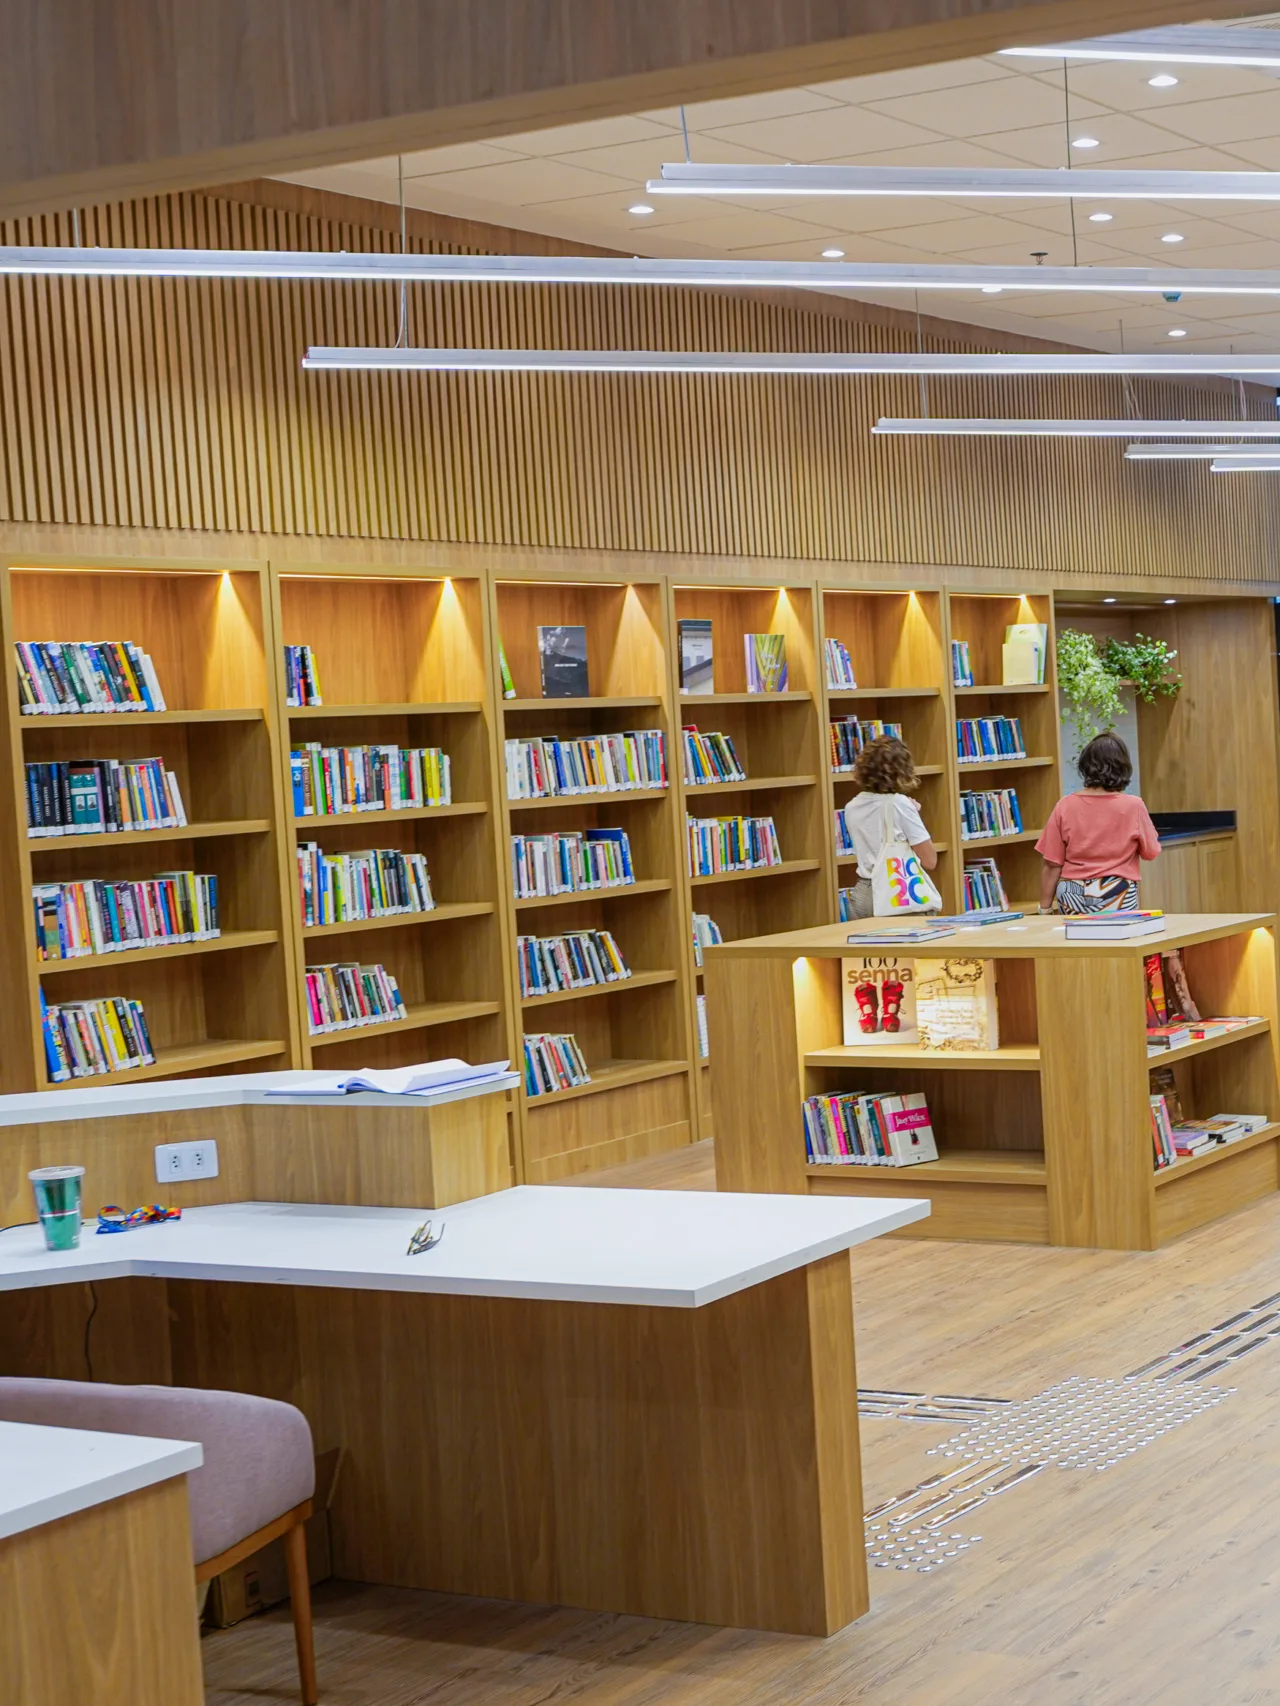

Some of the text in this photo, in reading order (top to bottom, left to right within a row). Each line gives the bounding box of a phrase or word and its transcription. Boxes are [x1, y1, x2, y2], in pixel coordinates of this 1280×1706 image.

[886, 857, 923, 879] RIO
[888, 877, 930, 908] 2C
[847, 968, 913, 984] senna
